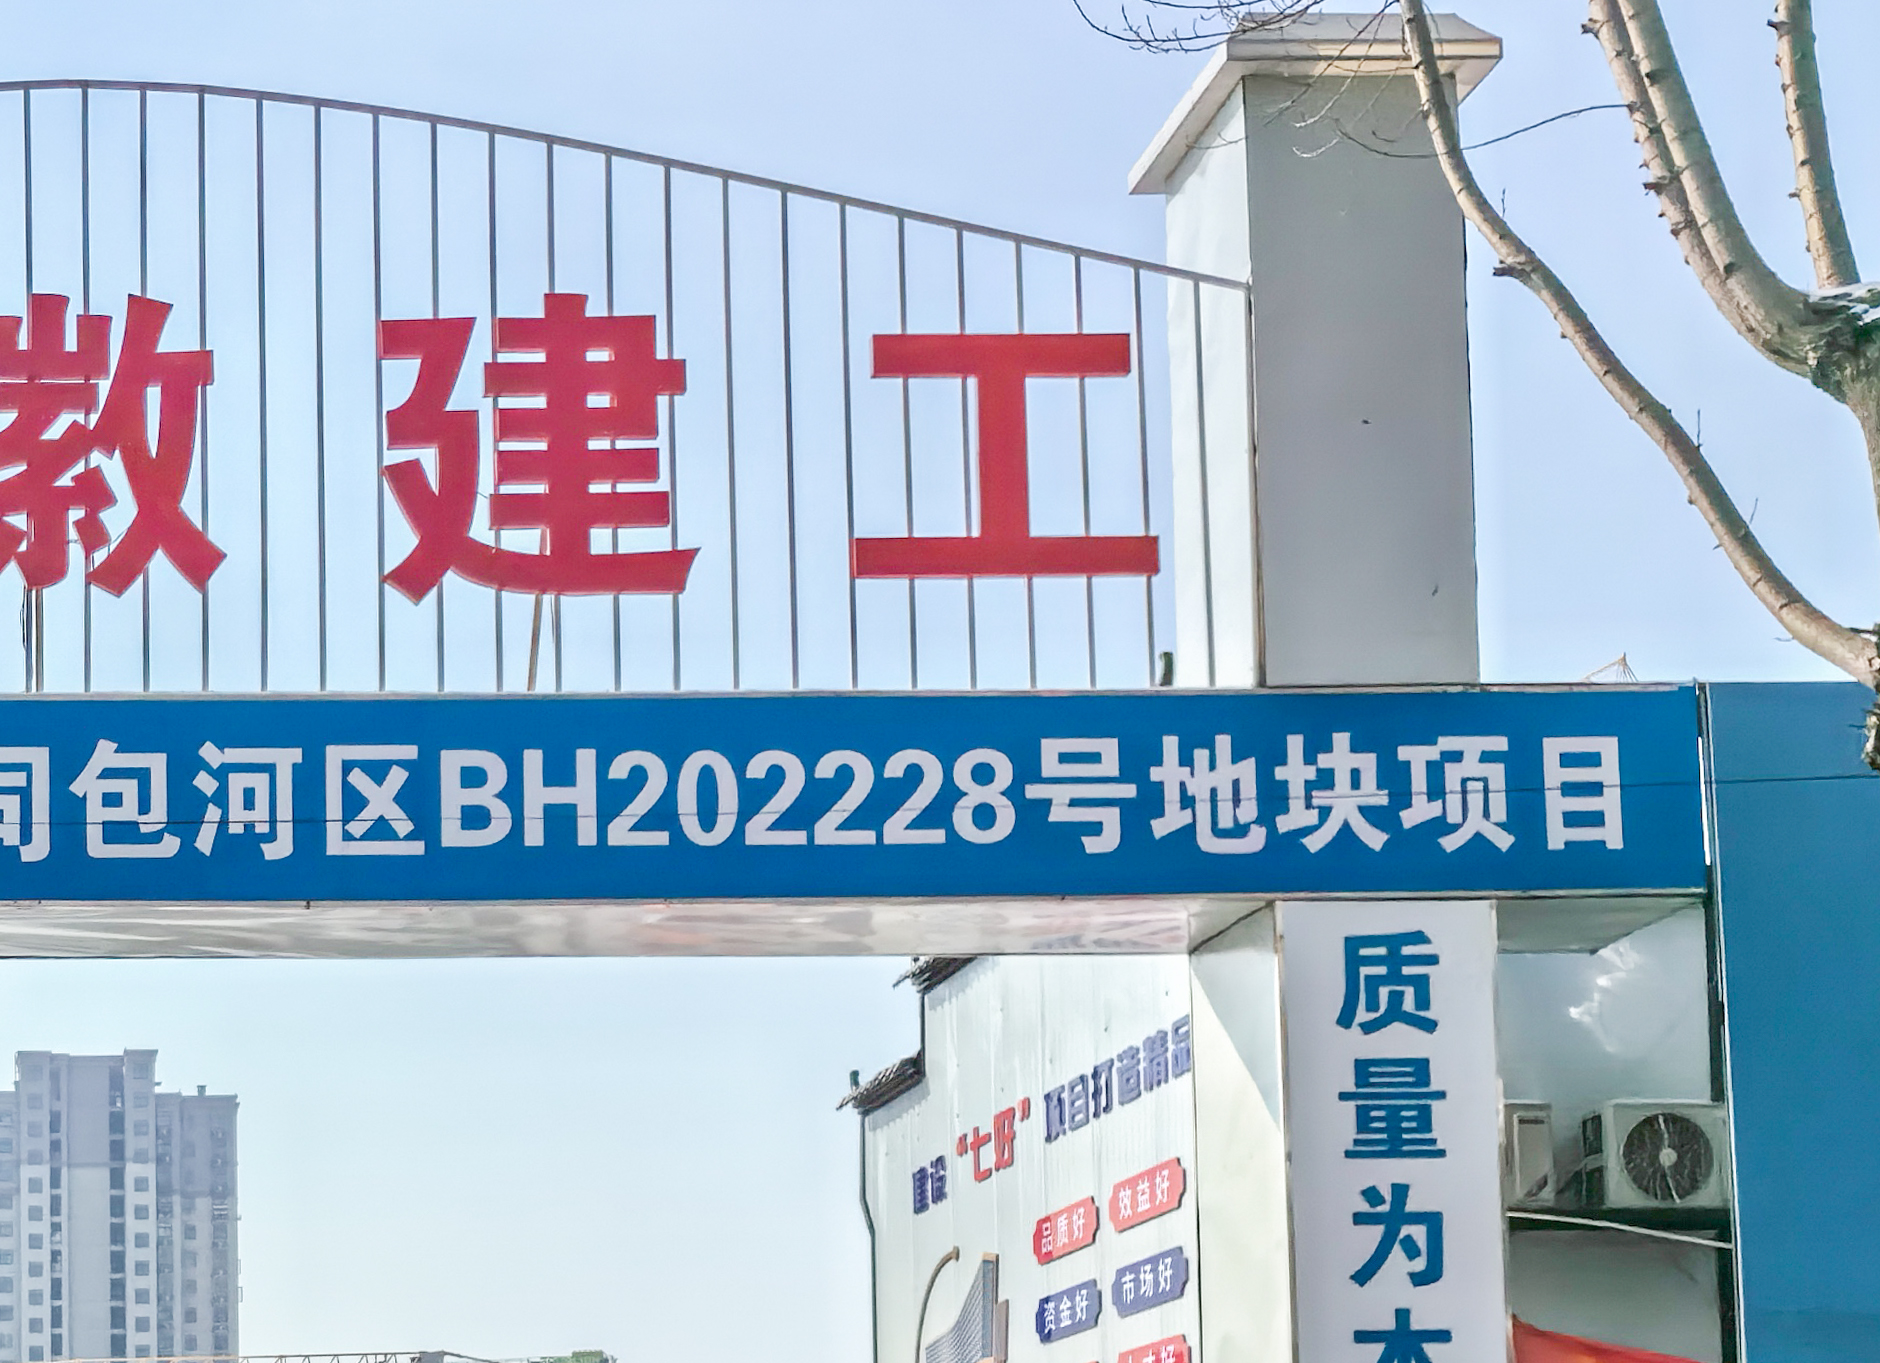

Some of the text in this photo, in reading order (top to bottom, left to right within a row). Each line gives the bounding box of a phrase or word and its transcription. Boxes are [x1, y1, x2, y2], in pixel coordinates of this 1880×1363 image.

[1118, 1169, 1170, 1220] 效益好
[1041, 1207, 1085, 1254] 品质好
[1121, 1257, 1173, 1304] 市场好
[1043, 1289, 1088, 1334] 资金好
